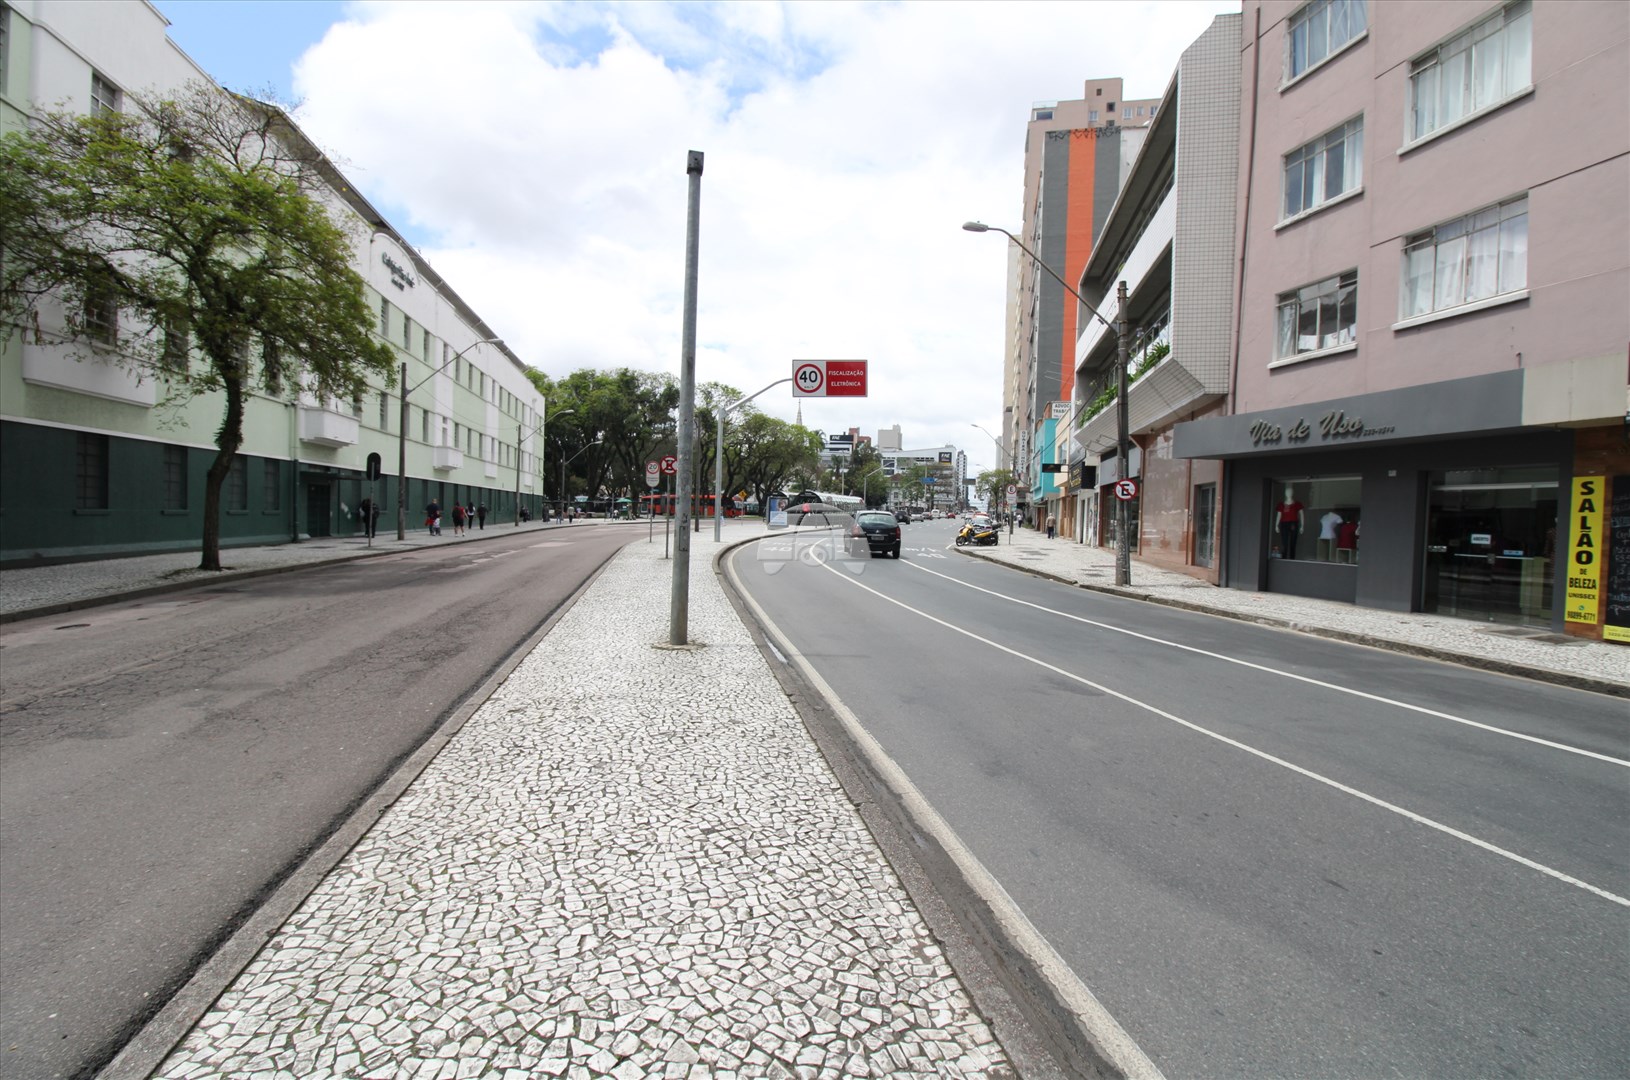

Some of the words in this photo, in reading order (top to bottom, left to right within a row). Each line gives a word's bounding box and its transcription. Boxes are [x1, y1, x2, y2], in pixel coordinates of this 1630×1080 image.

[799, 370, 818, 383] 40
[1250, 419, 1281, 446] Via
[1288, 416, 1310, 442] de
[1320, 409, 1364, 438] Uso
[1575, 480, 1596, 565] SALÃO
[1579, 568, 1588, 576] DE
[1568, 577, 1597, 590] BELEZA
[1567, 592, 1596, 600] UNISSEX
